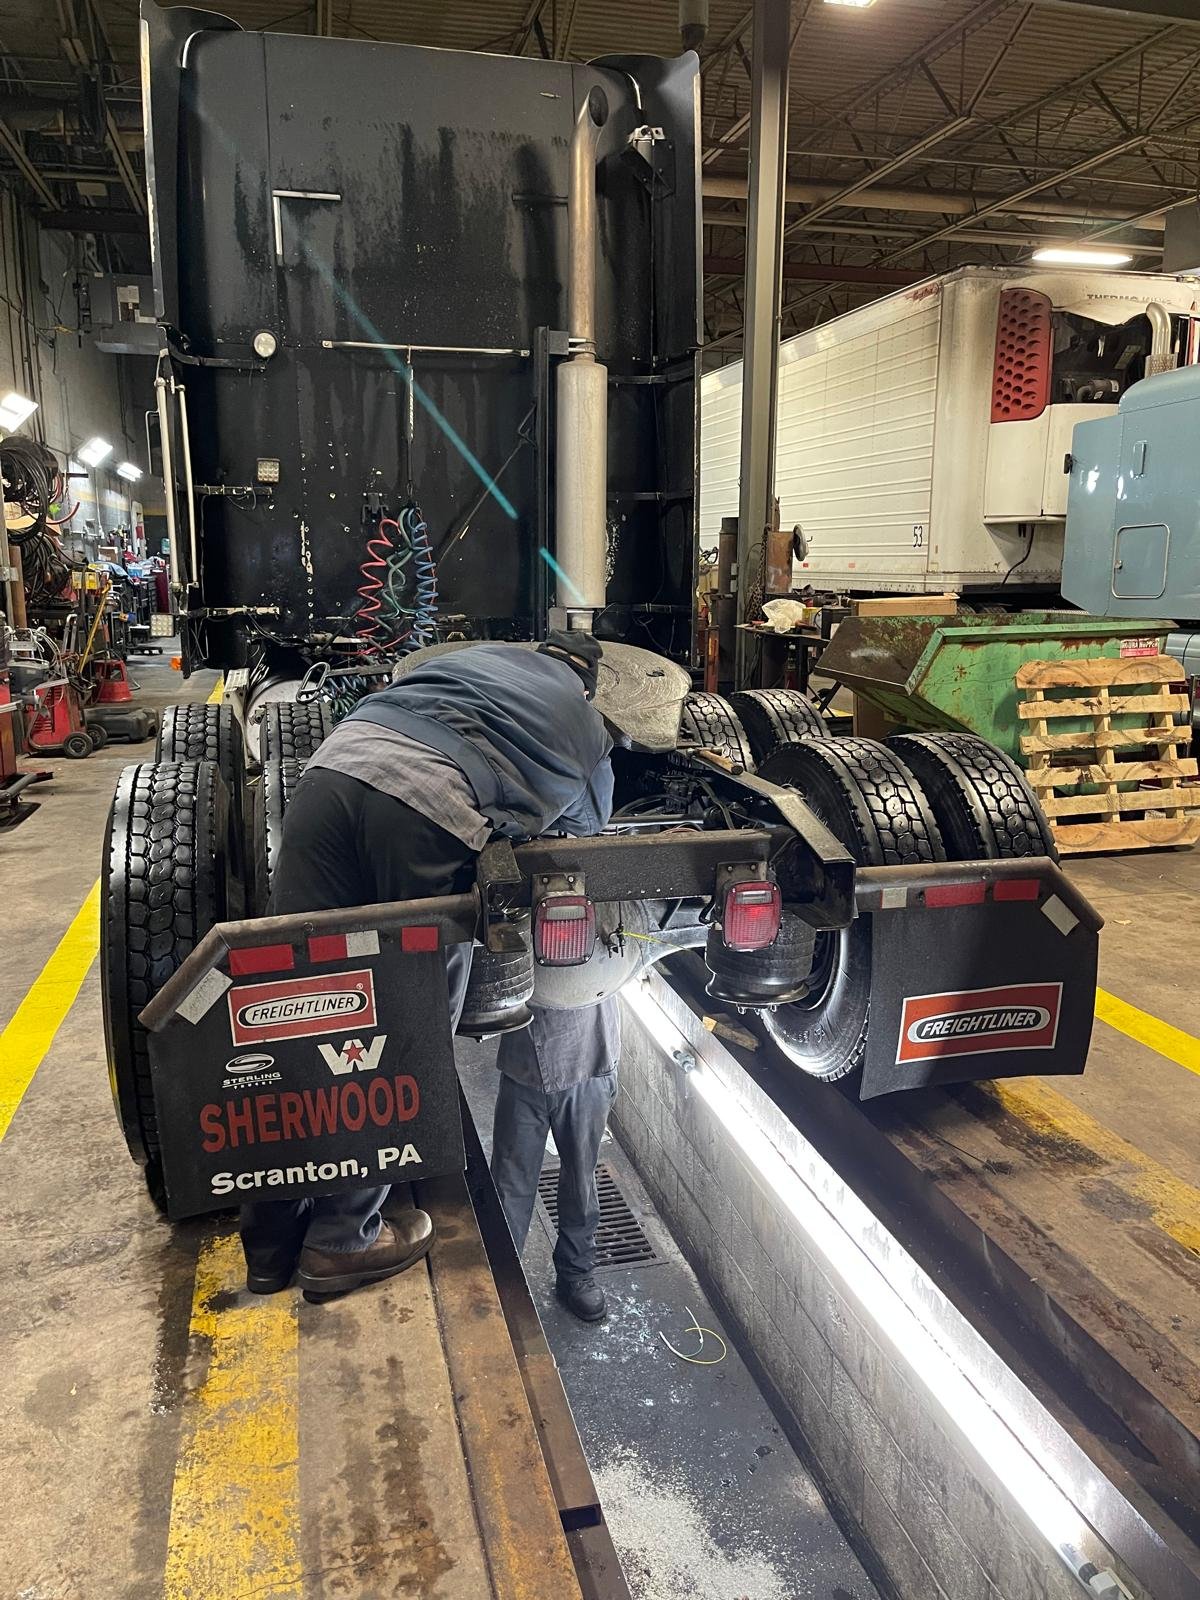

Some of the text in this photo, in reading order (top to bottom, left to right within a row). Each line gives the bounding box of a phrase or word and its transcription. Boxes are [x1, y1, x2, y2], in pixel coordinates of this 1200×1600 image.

[913, 525, 923, 548] 53
[252, 996, 354, 1022] FREIGHTLINER
[921, 1012, 1036, 1037] FREIGHTLINER
[223, 1072, 281, 1085] STERLING
[200, 1075, 420, 1152] SHERWOOD
[211, 1144, 422, 1195] Scranton, PA
